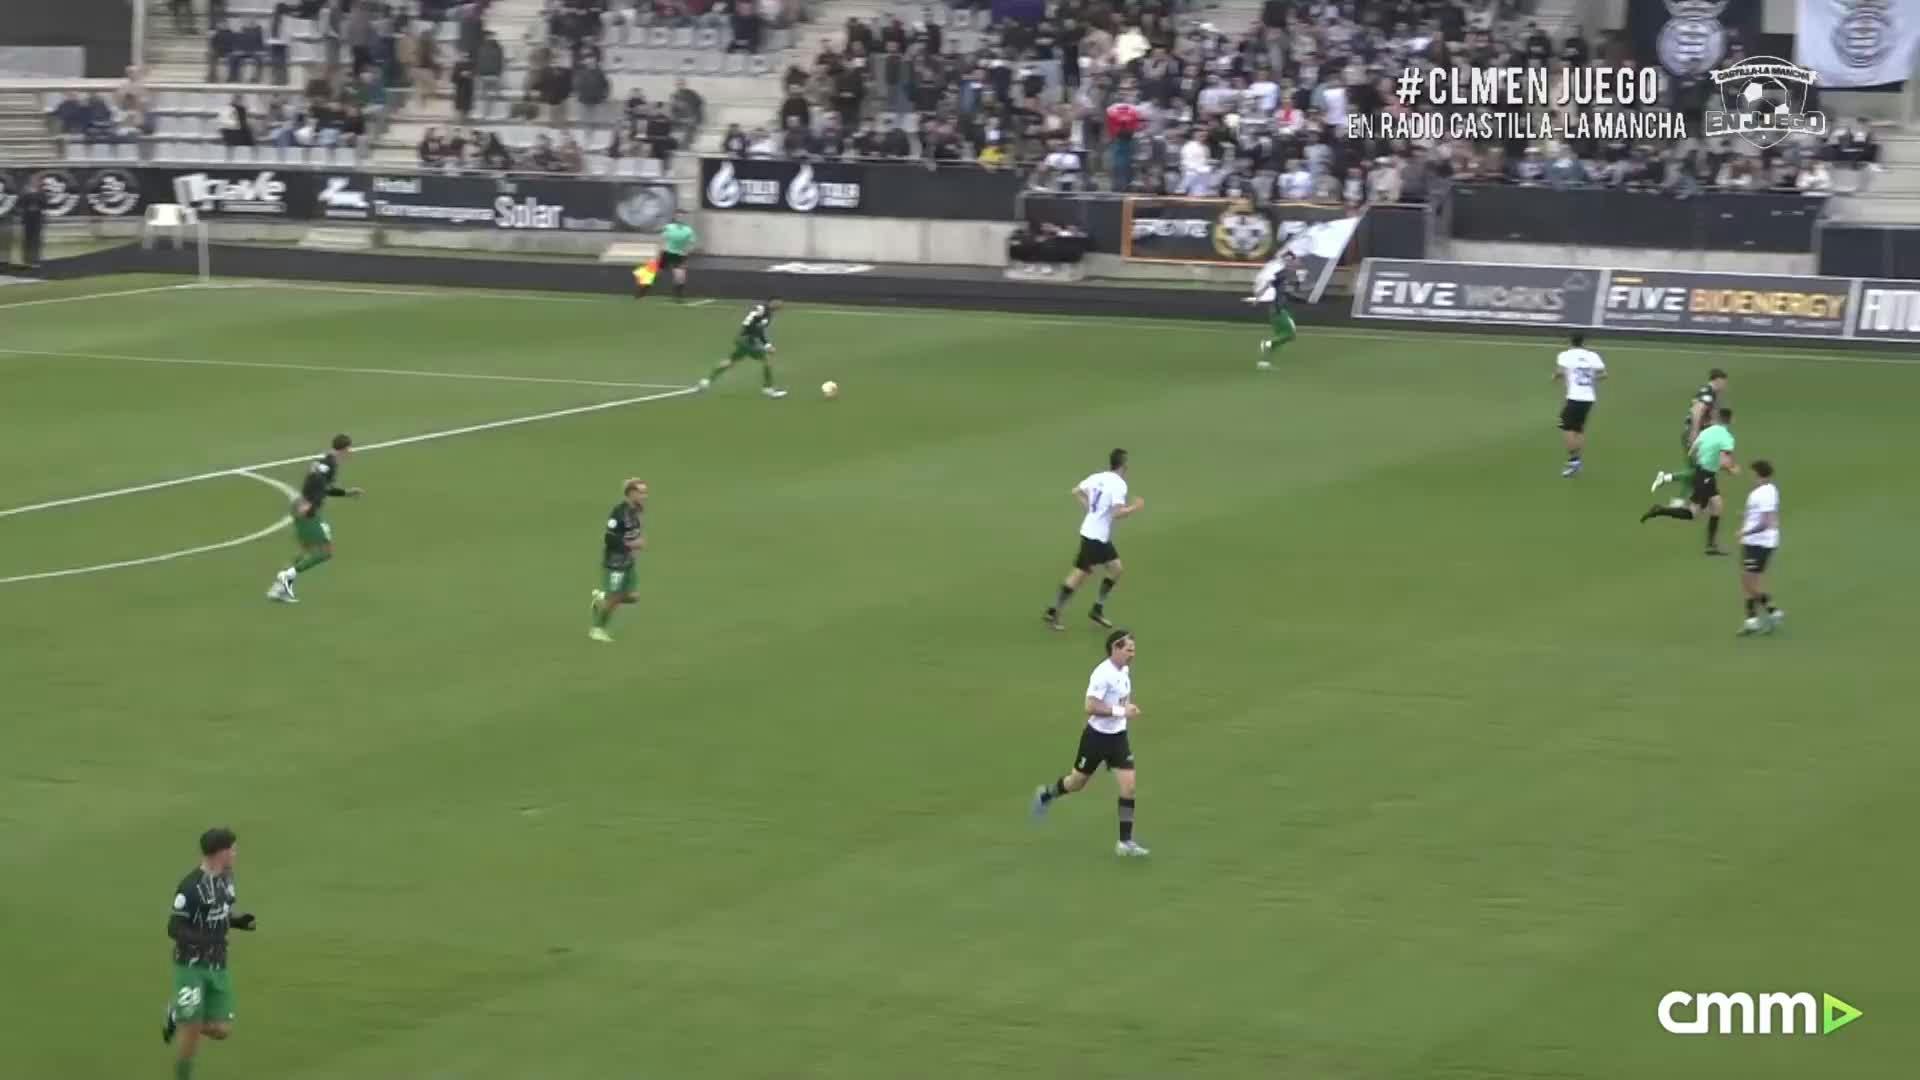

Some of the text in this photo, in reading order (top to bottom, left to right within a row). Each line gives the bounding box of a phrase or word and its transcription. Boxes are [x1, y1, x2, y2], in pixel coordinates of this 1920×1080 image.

[494, 196, 564, 229] Solar
[1370, 279, 1458, 307] FIVE
[1605, 285, 1847, 319] FIVE BIOENERGY
